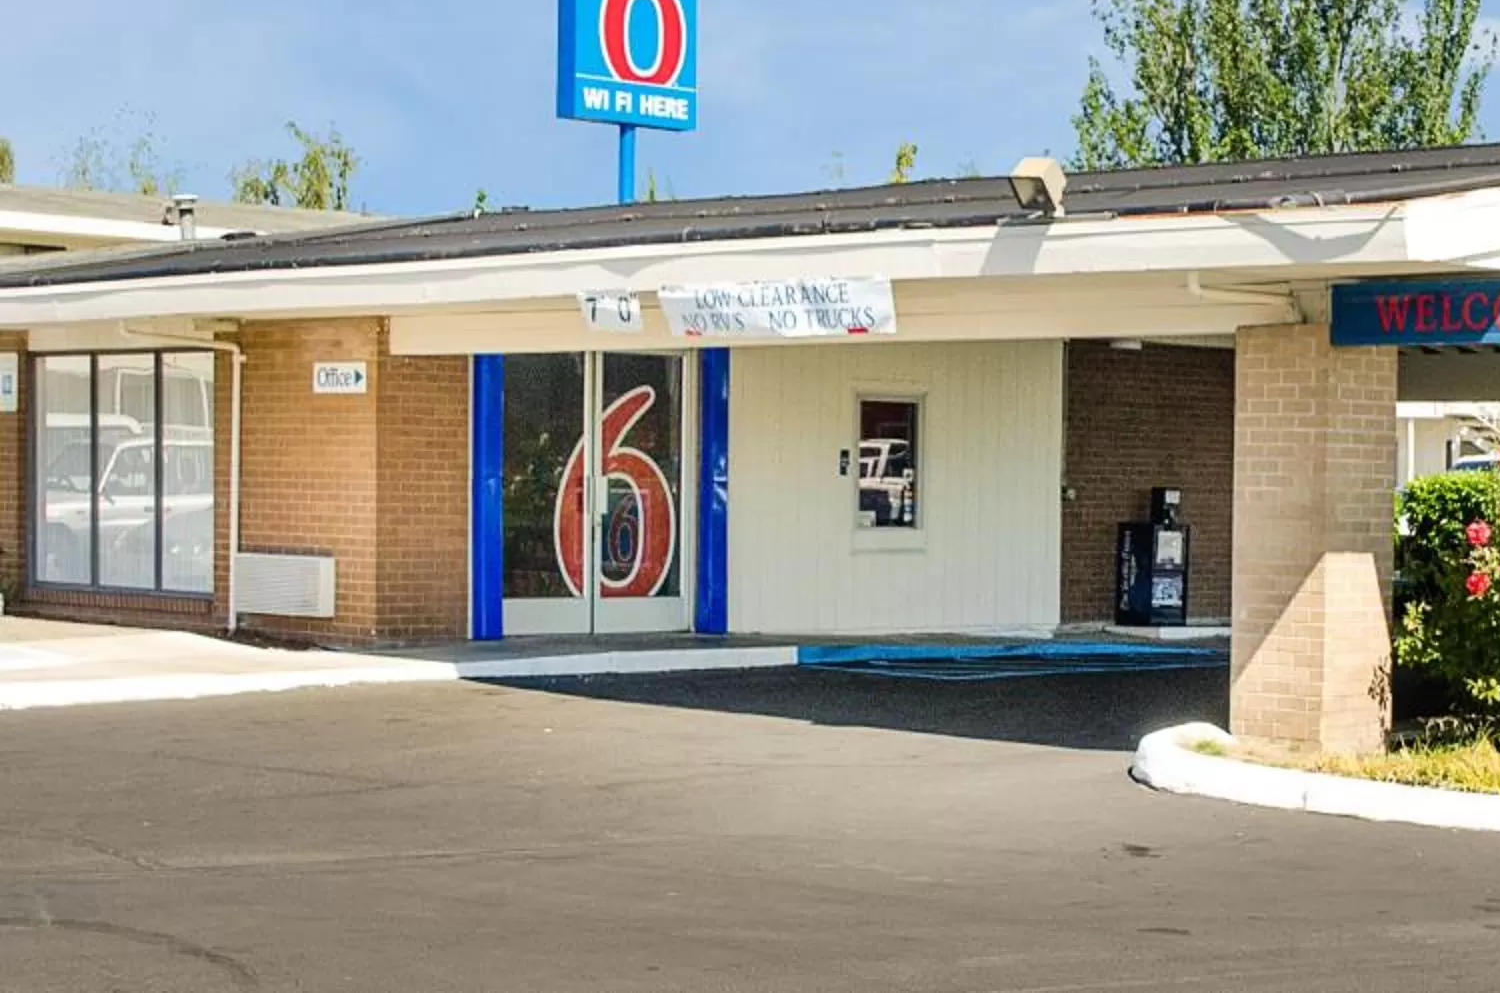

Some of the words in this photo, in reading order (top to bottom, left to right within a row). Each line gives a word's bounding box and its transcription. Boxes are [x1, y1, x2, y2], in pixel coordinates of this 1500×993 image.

[583, 87, 609, 111] WI
[616, 90, 632, 114] FI
[639, 94, 689, 120] HERE
[694, 288, 732, 309] LOW
[737, 282, 849, 308] CLEARANCE
[768, 309, 798, 331] NO
[805, 306, 876, 329] TRUCKS
[317, 366, 352, 387] Office
[554, 385, 676, 599] 6
